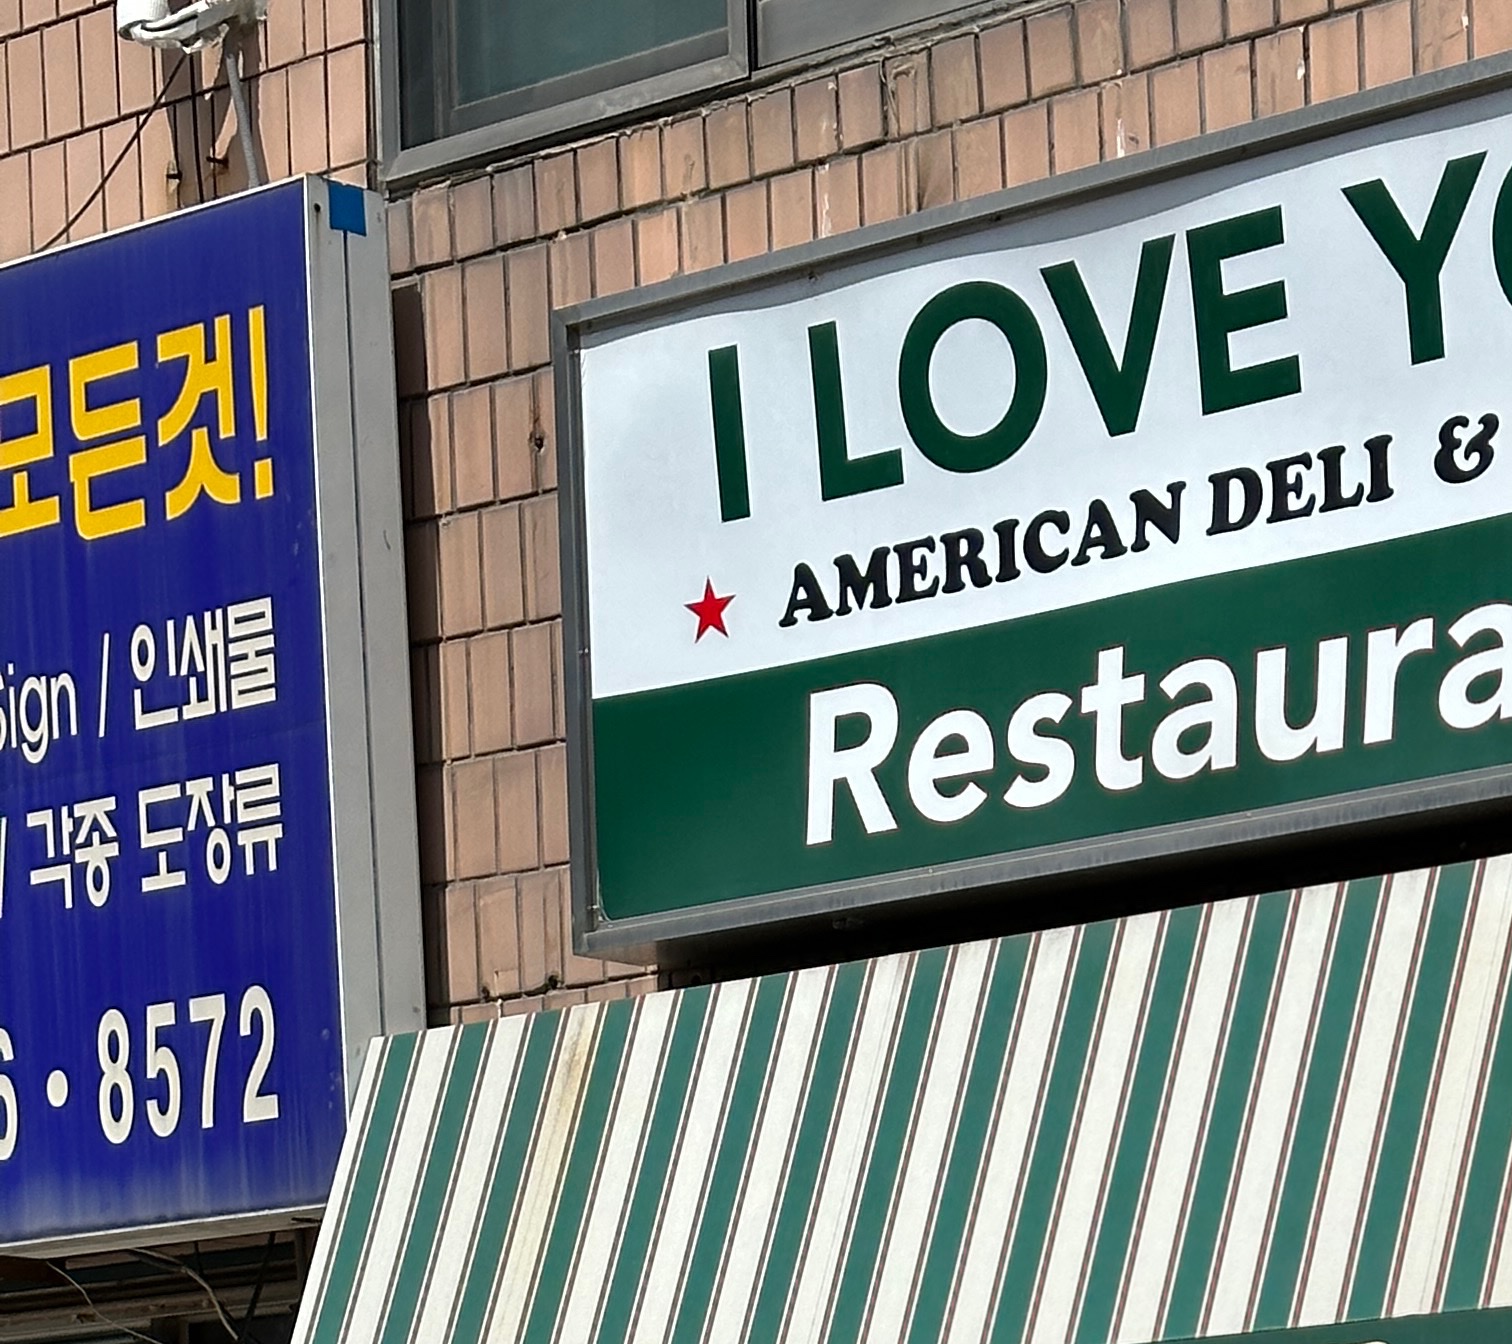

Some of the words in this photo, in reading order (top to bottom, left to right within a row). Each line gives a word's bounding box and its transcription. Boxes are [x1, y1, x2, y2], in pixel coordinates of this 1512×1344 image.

[707, 344, 752, 523] I
[806, 204, 1302, 504] LOVE
[778, 478, 1187, 630] AMERICAN
[1204, 435, 1394, 537] DELI
[1432, 412, 1498, 486] &
[130, 596, 277, 731] 인쇄물
[26, 795, 120, 910] 각종
[137, 762, 283, 894] 도장류
[97, 984, 280, 1145] 8572
